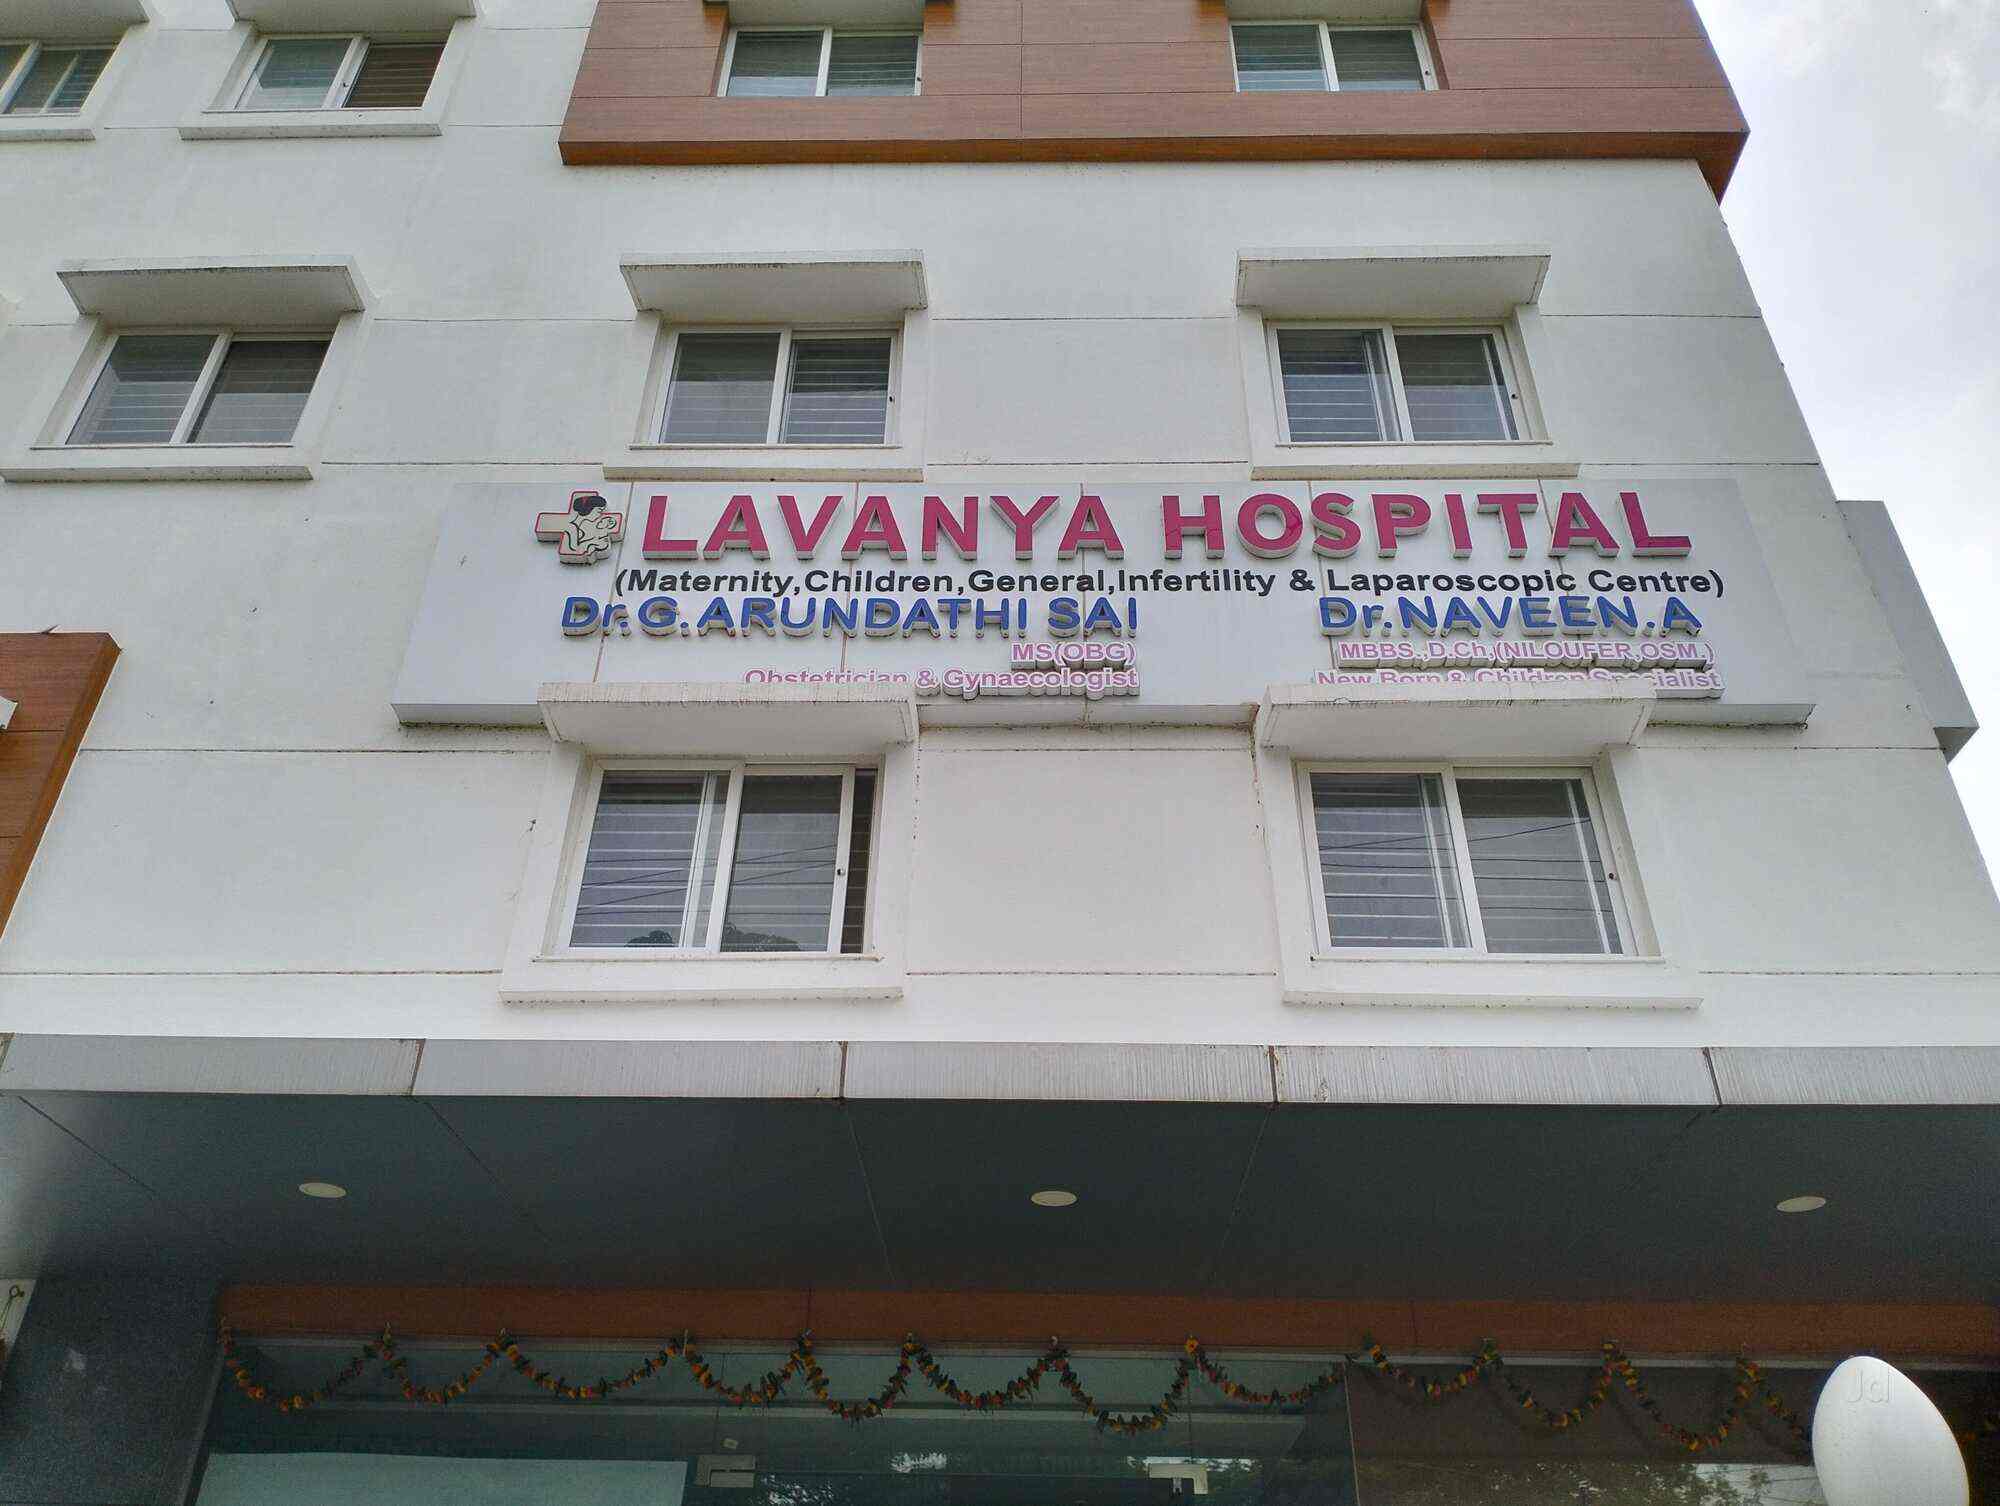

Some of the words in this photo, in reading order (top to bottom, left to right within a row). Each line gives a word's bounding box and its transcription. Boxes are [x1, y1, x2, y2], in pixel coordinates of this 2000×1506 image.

[642, 495, 1125, 560] LAVANYA
[1160, 491, 1692, 559] HOSPITAL
[615, 568, 1275, 597] (Maternity,Children,General,Infertility
[1289, 568, 1316, 592] &
[1328, 569, 1577, 596] Laparoscopic
[1587, 569, 1724, 598] Centre)
[562, 596, 1028, 638] Dr.G.ARUNDATHI
[1047, 596, 1137, 638] SAI
[1319, 595, 1702, 637] Dr.NAVEEN.A
[1011, 642, 1136, 664] MS(OBG)
[916, 669, 937, 687] &
[943, 668, 1139, 693] Gynaecologist
[1317, 671, 1372, 684] New
[1592, 671, 1720, 687] Sialist
